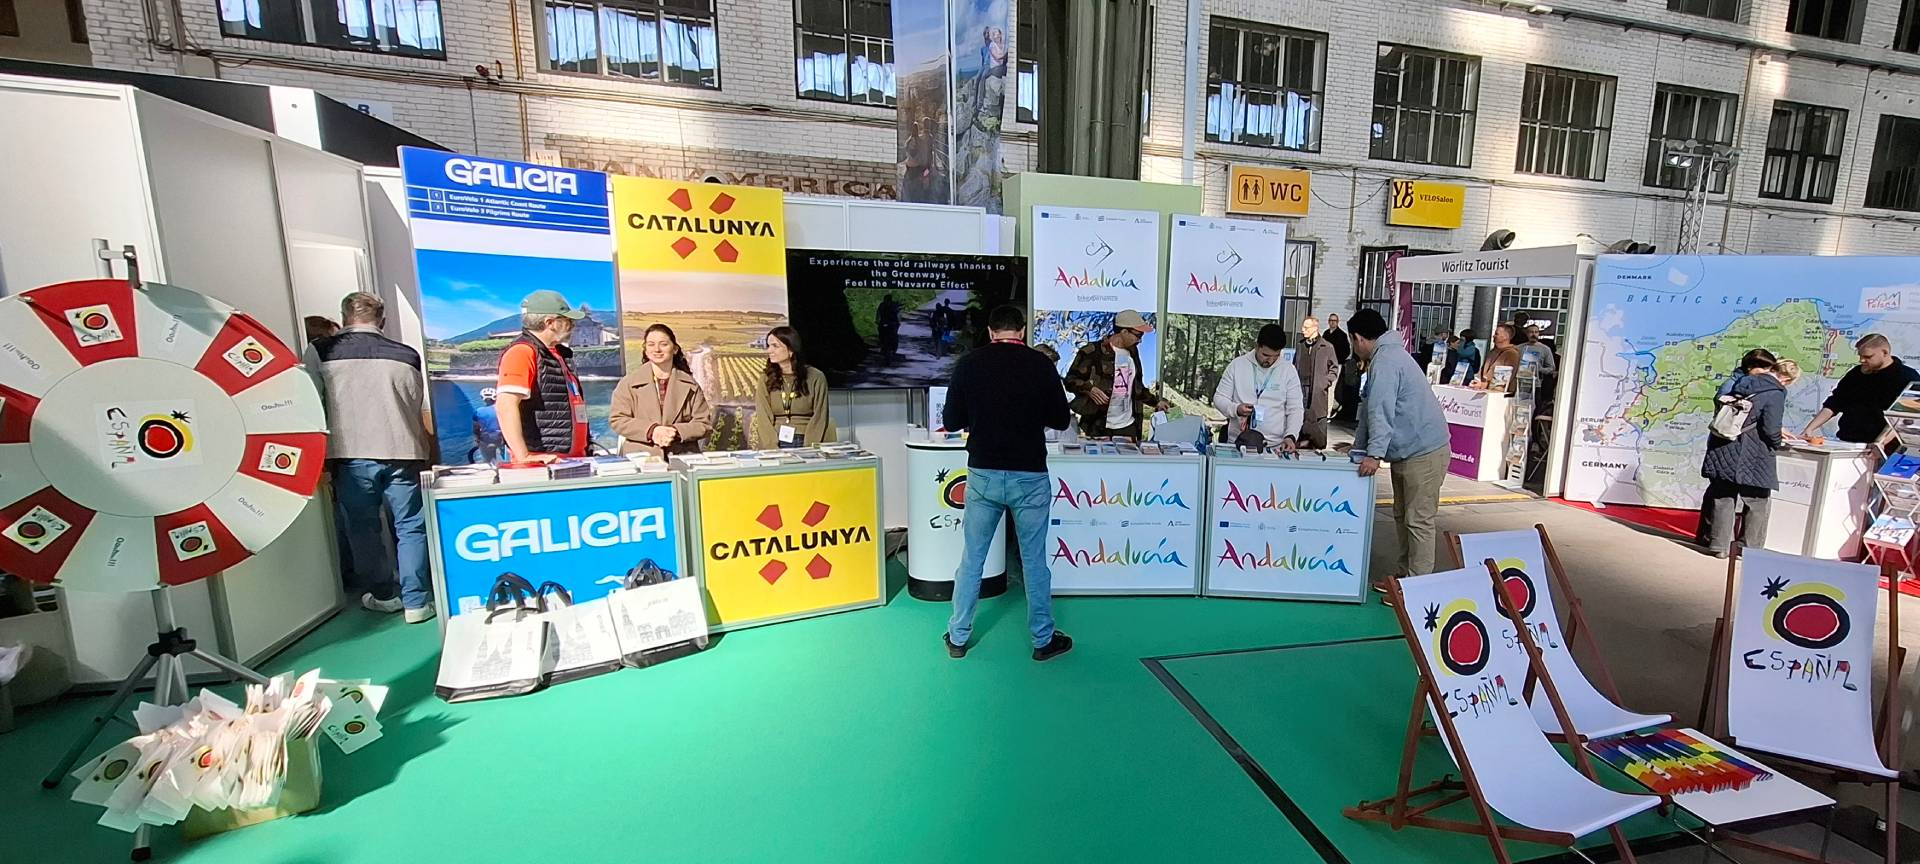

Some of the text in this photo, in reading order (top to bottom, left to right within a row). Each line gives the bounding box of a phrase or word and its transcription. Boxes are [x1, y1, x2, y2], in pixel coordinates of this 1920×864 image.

[444, 158, 578, 195] GALICIA
[449, 194, 478, 203] EuroVelo
[485, 197, 510, 206] Atlantic
[510, 200, 528, 208] Coast
[1270, 182, 1302, 202] WC
[450, 205, 480, 213] EuroVelo
[486, 208, 511, 217] Pilgrims
[511, 210, 530, 218] Route
[628, 213, 775, 237] CATALUNYA
[809, 257, 1005, 271] Experience the old railways thanks to
[1441, 258, 1509, 273] Wörlitz Tourist
[845, 279, 867, 287] Feel
[871, 280, 887, 288] the
[871, 270, 950, 280] the Greenways.
[1054, 265, 1141, 291] Andalucía
[1185, 271, 1264, 298] Andalucía
[1626, 294, 1758, 305] BALTIC SEA
[1460, 407, 1482, 418] Tourist
[1581, 460, 1628, 470] GERMANY
[1051, 477, 1191, 510] Andalucía
[1221, 480, 1359, 518] Andalucía
[929, 514, 964, 531] ESP
[455, 507, 666, 562] GALICIA
[710, 526, 871, 561] CATALUNYA
[1050, 536, 1189, 568] Andalucía
[1217, 538, 1354, 576] Andalucía
